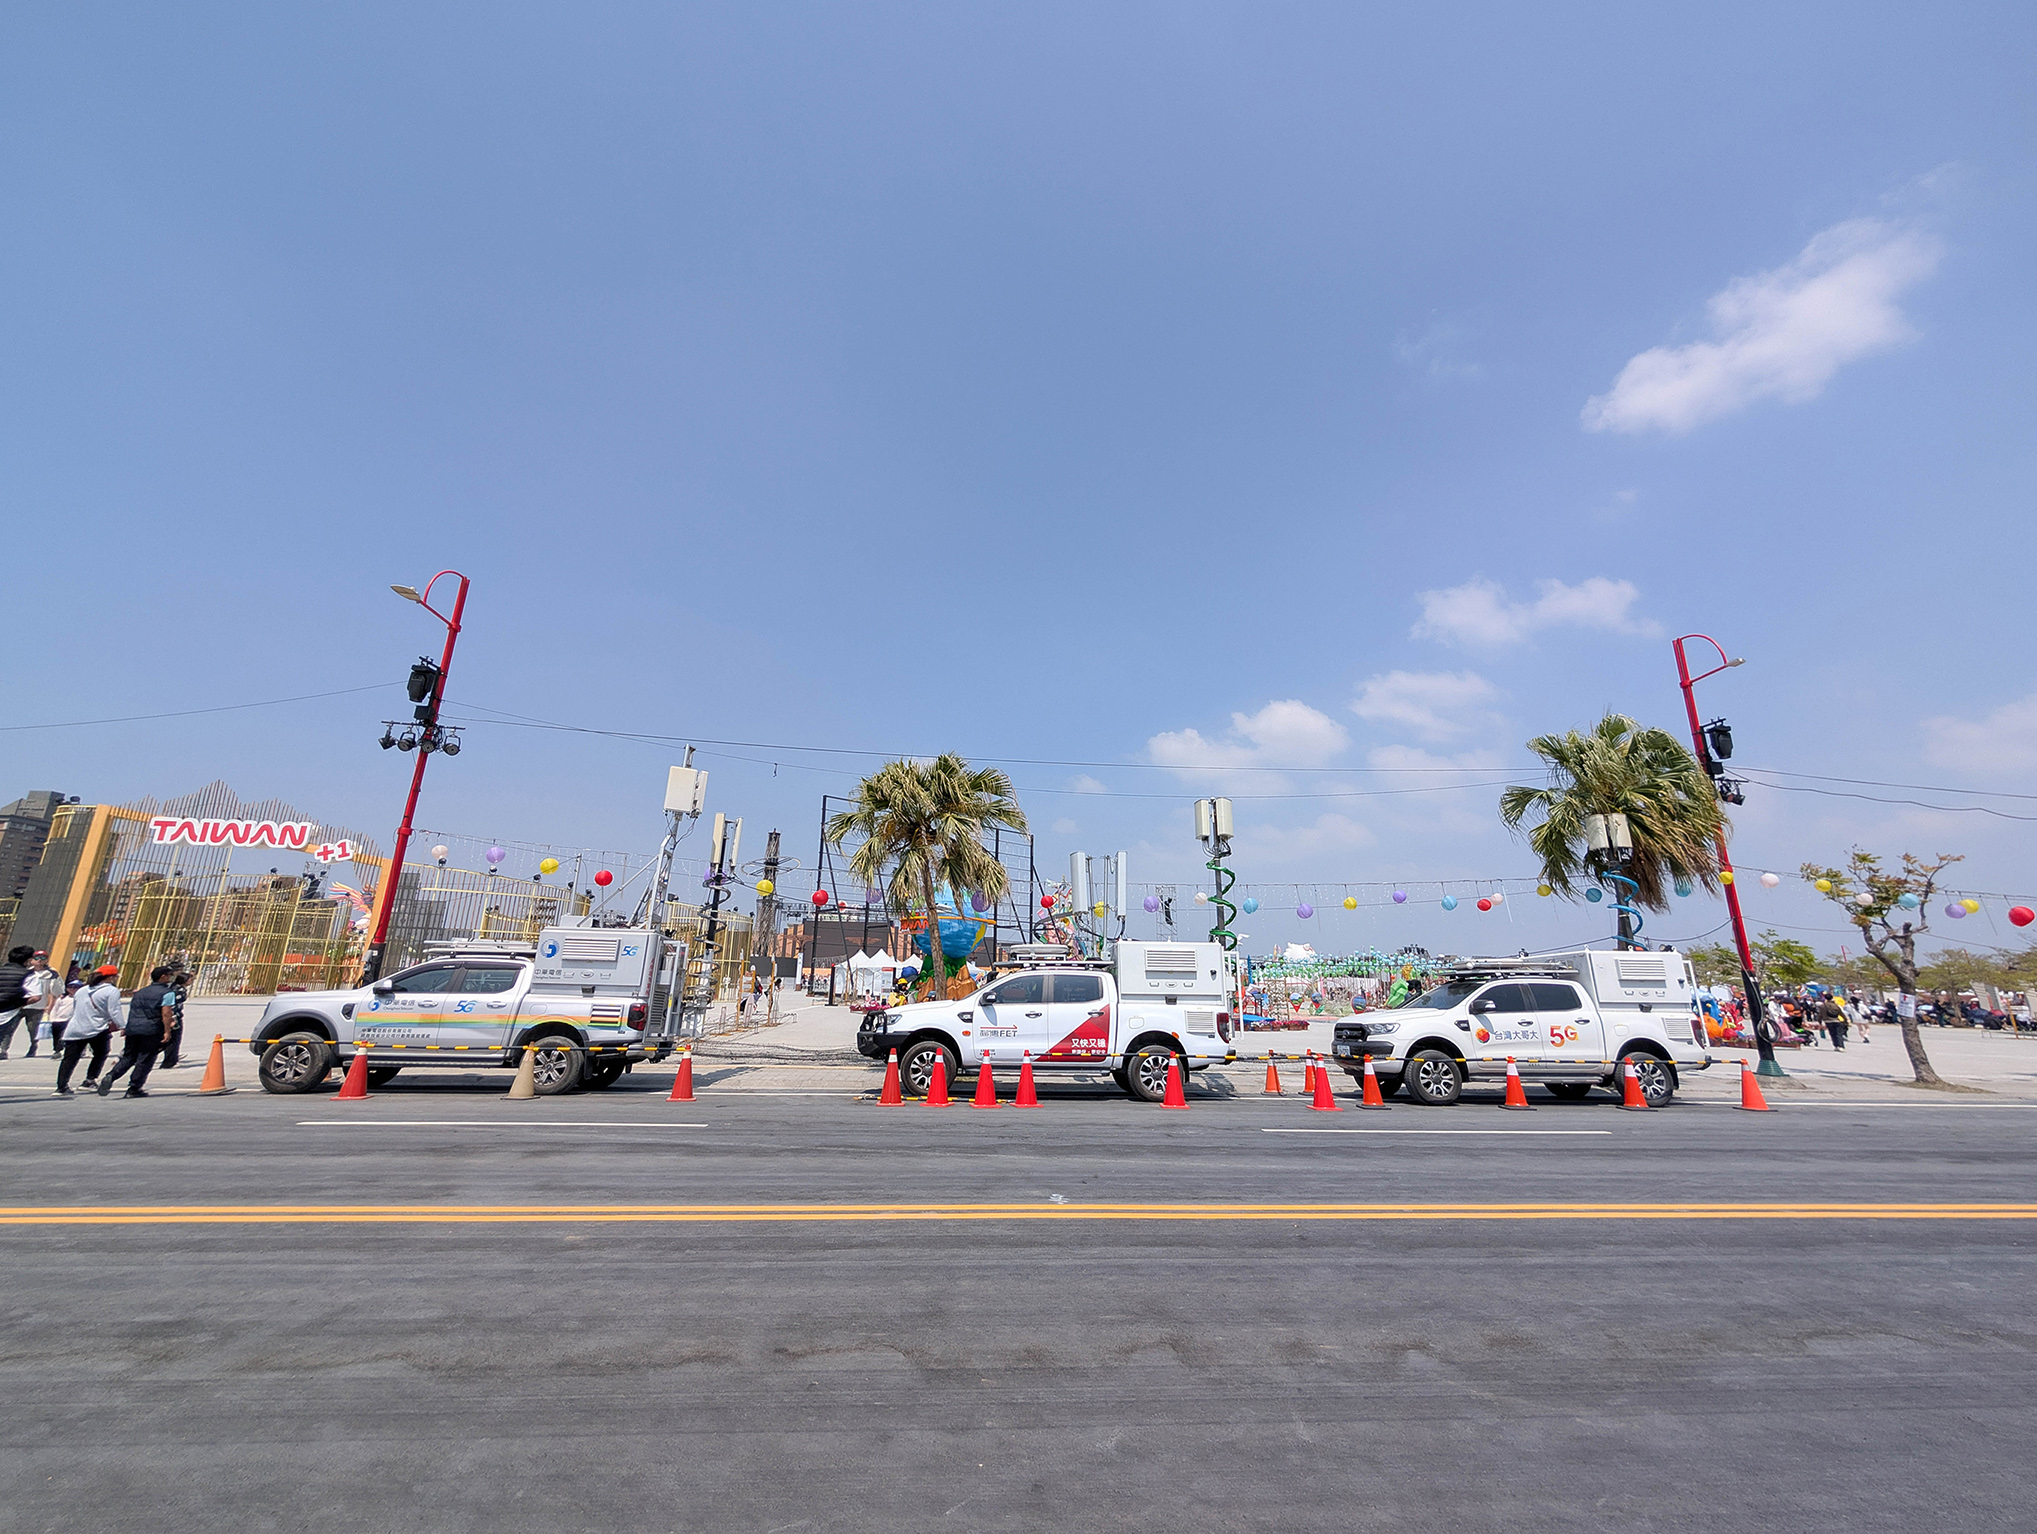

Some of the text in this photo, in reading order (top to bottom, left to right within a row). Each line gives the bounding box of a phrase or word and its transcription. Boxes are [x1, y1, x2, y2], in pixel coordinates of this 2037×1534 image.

[153, 820, 307, 847] TAIWAN
[316, 841, 351, 862] +1
[621, 945, 639, 957] 5G
[453, 1000, 477, 1013] 5G
[1494, 1030, 1539, 1040] 台灣大哥大
[1549, 1025, 1579, 1047] 5G
